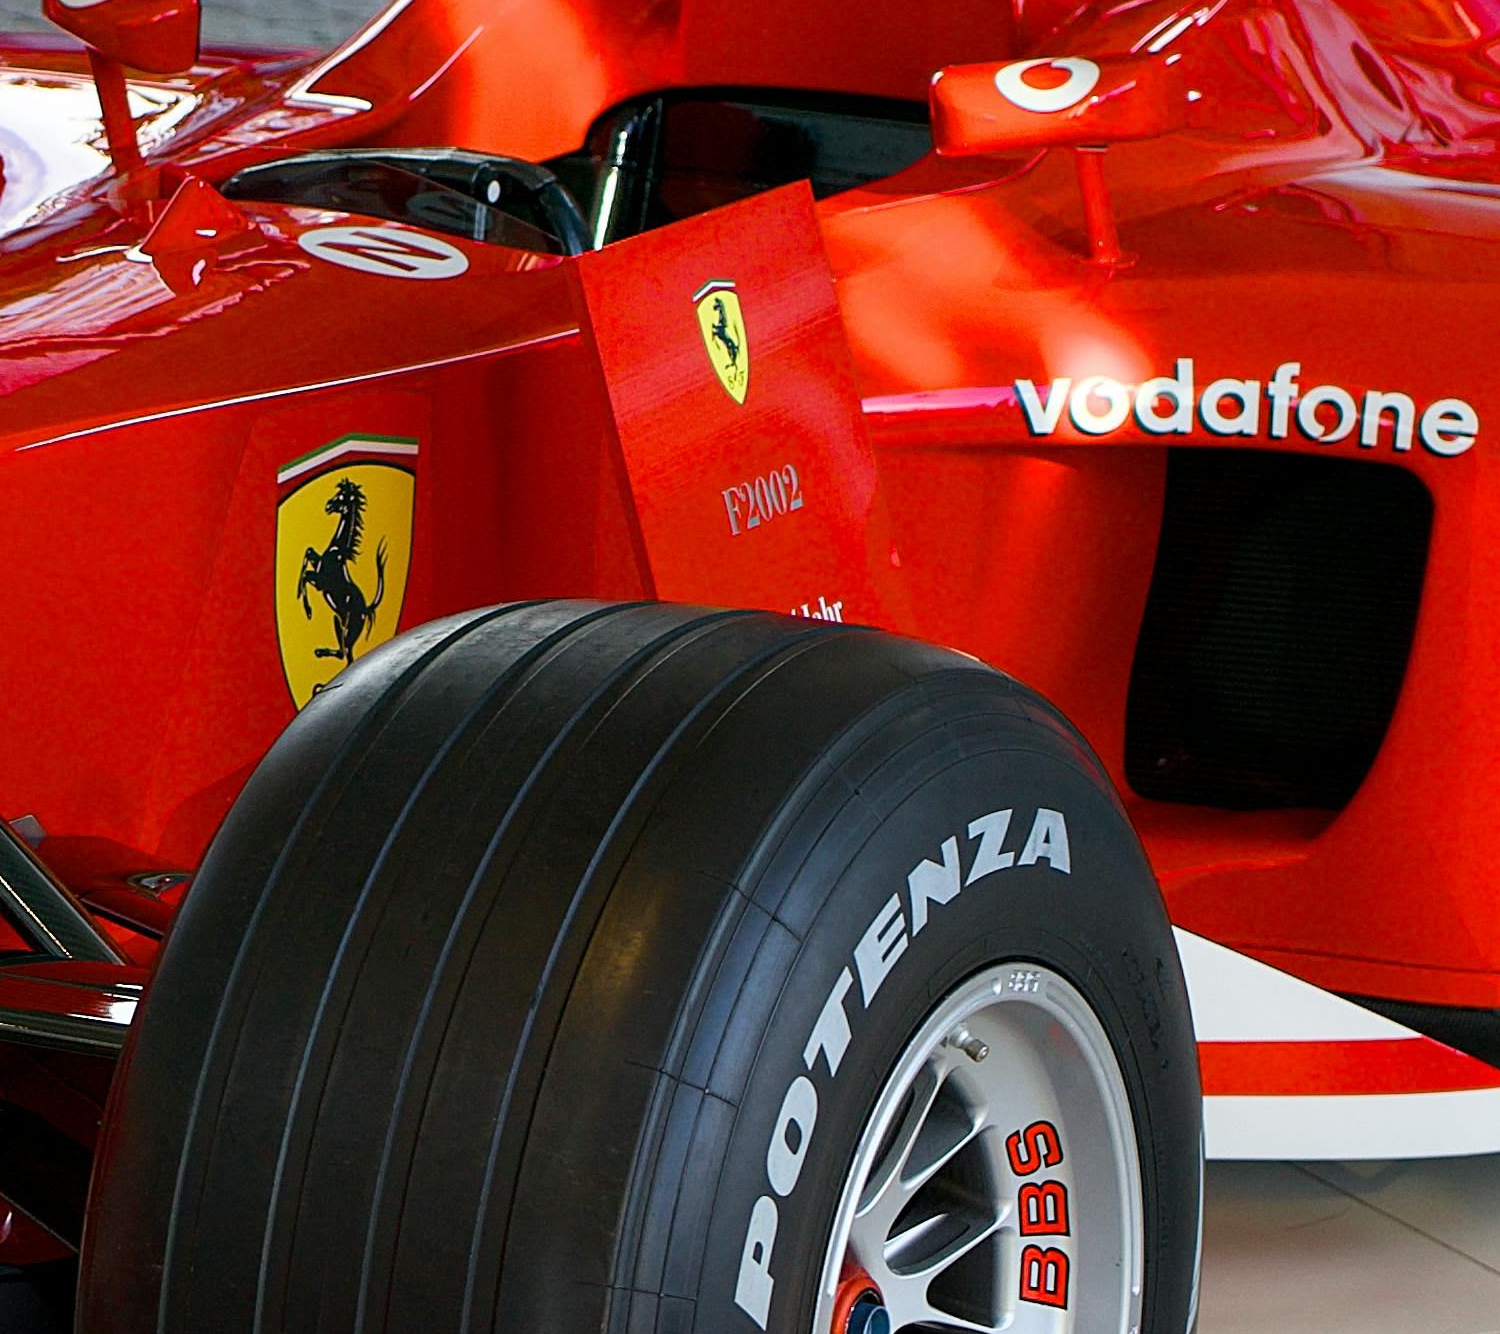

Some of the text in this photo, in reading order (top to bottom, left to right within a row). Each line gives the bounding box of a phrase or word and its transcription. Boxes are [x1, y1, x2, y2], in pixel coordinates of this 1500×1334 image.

[1014, 358, 1479, 456] vodafone
[721, 464, 804, 535] F2002
[734, 807, 1072, 1331] POTENZA
[1006, 1120, 1071, 1310] BBS
